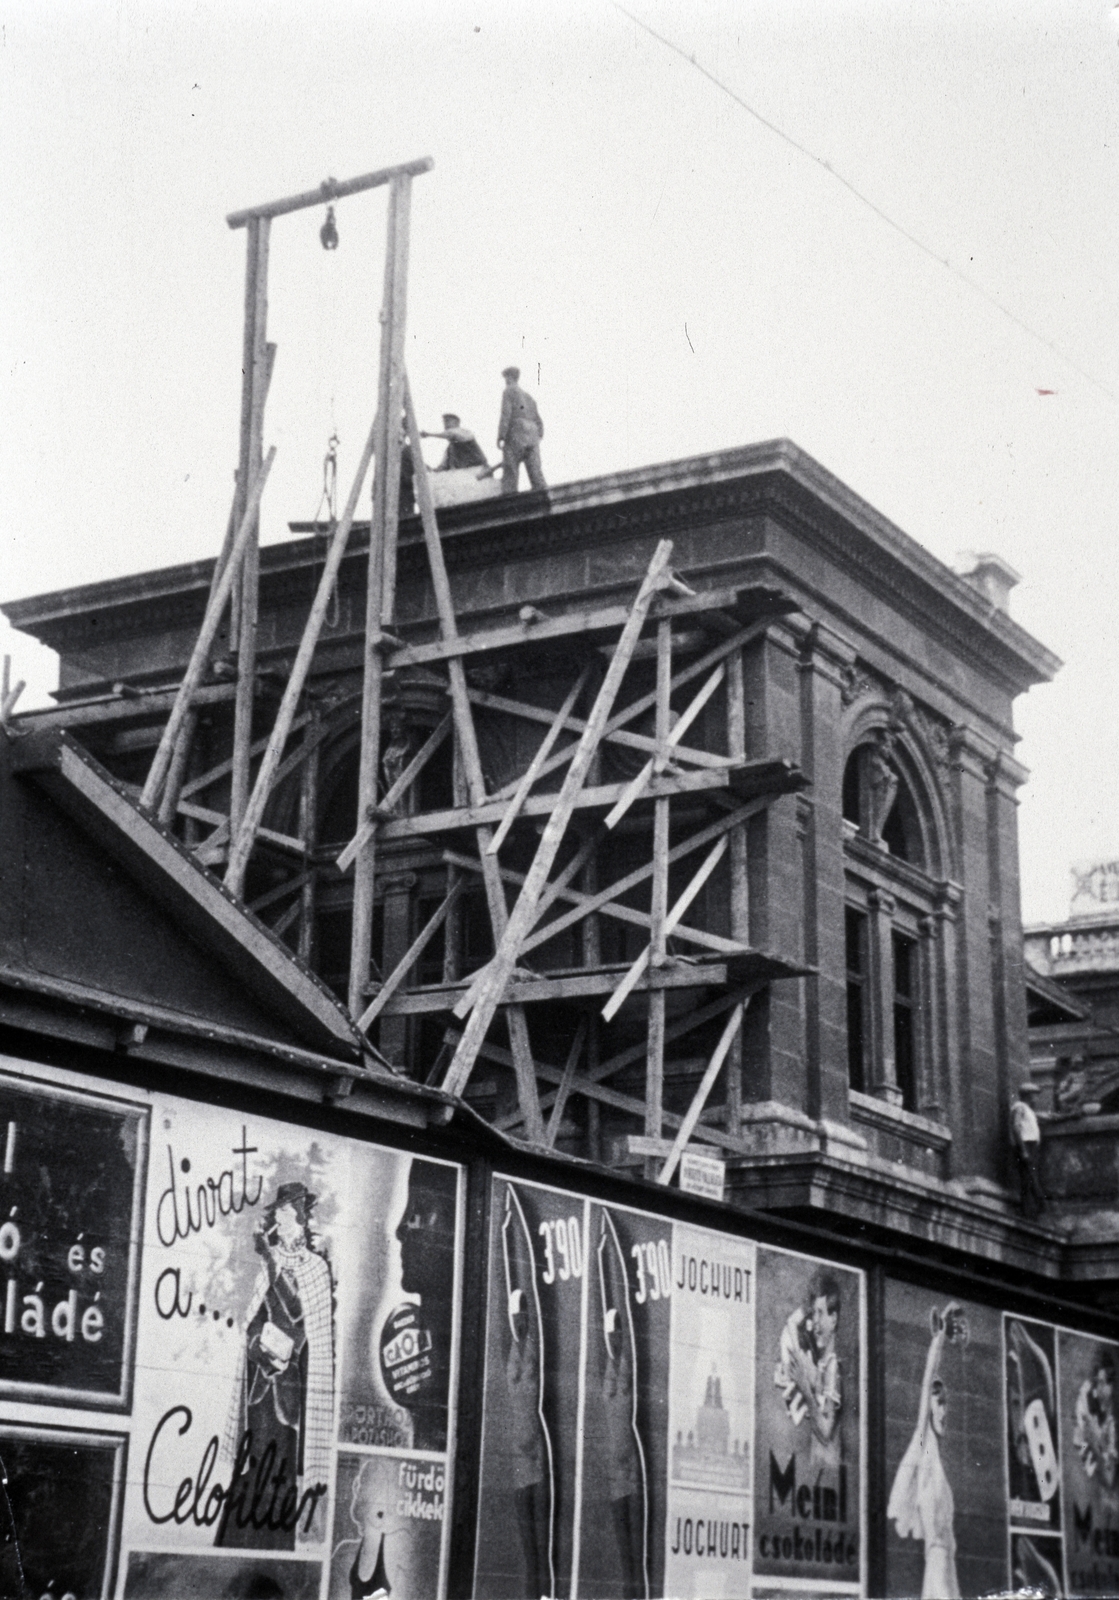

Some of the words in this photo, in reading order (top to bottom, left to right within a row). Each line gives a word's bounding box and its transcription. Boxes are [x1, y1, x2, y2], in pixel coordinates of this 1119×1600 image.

[157, 1124, 262, 1247] divat
[68, 1232, 106, 1274] és
[4, 1278, 104, 1342] ládé
[143, 1405, 328, 1535] Celofilter
[769, 1449, 848, 1523] Meinl
